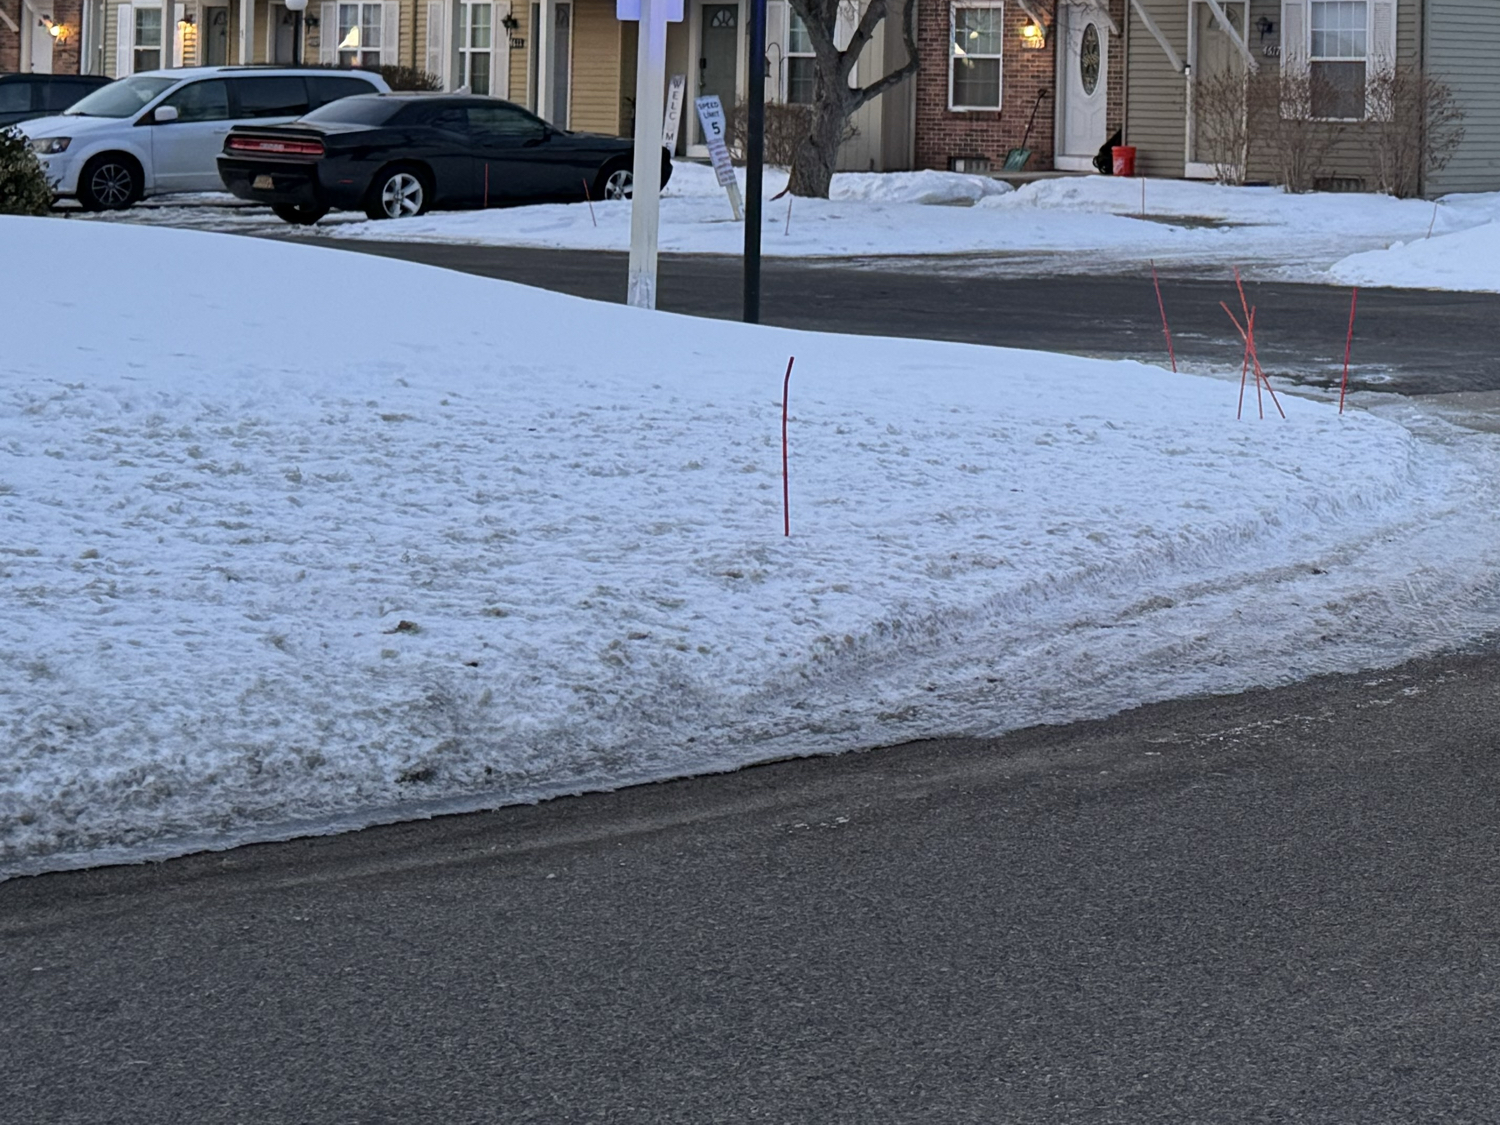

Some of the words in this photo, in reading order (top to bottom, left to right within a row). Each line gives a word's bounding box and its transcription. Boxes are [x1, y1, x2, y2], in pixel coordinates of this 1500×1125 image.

[698, 101, 719, 111] SPEED
[665, 78, 682, 149] WELCME
[703, 111, 720, 119] LIMIT
[711, 121, 721, 135] 5
